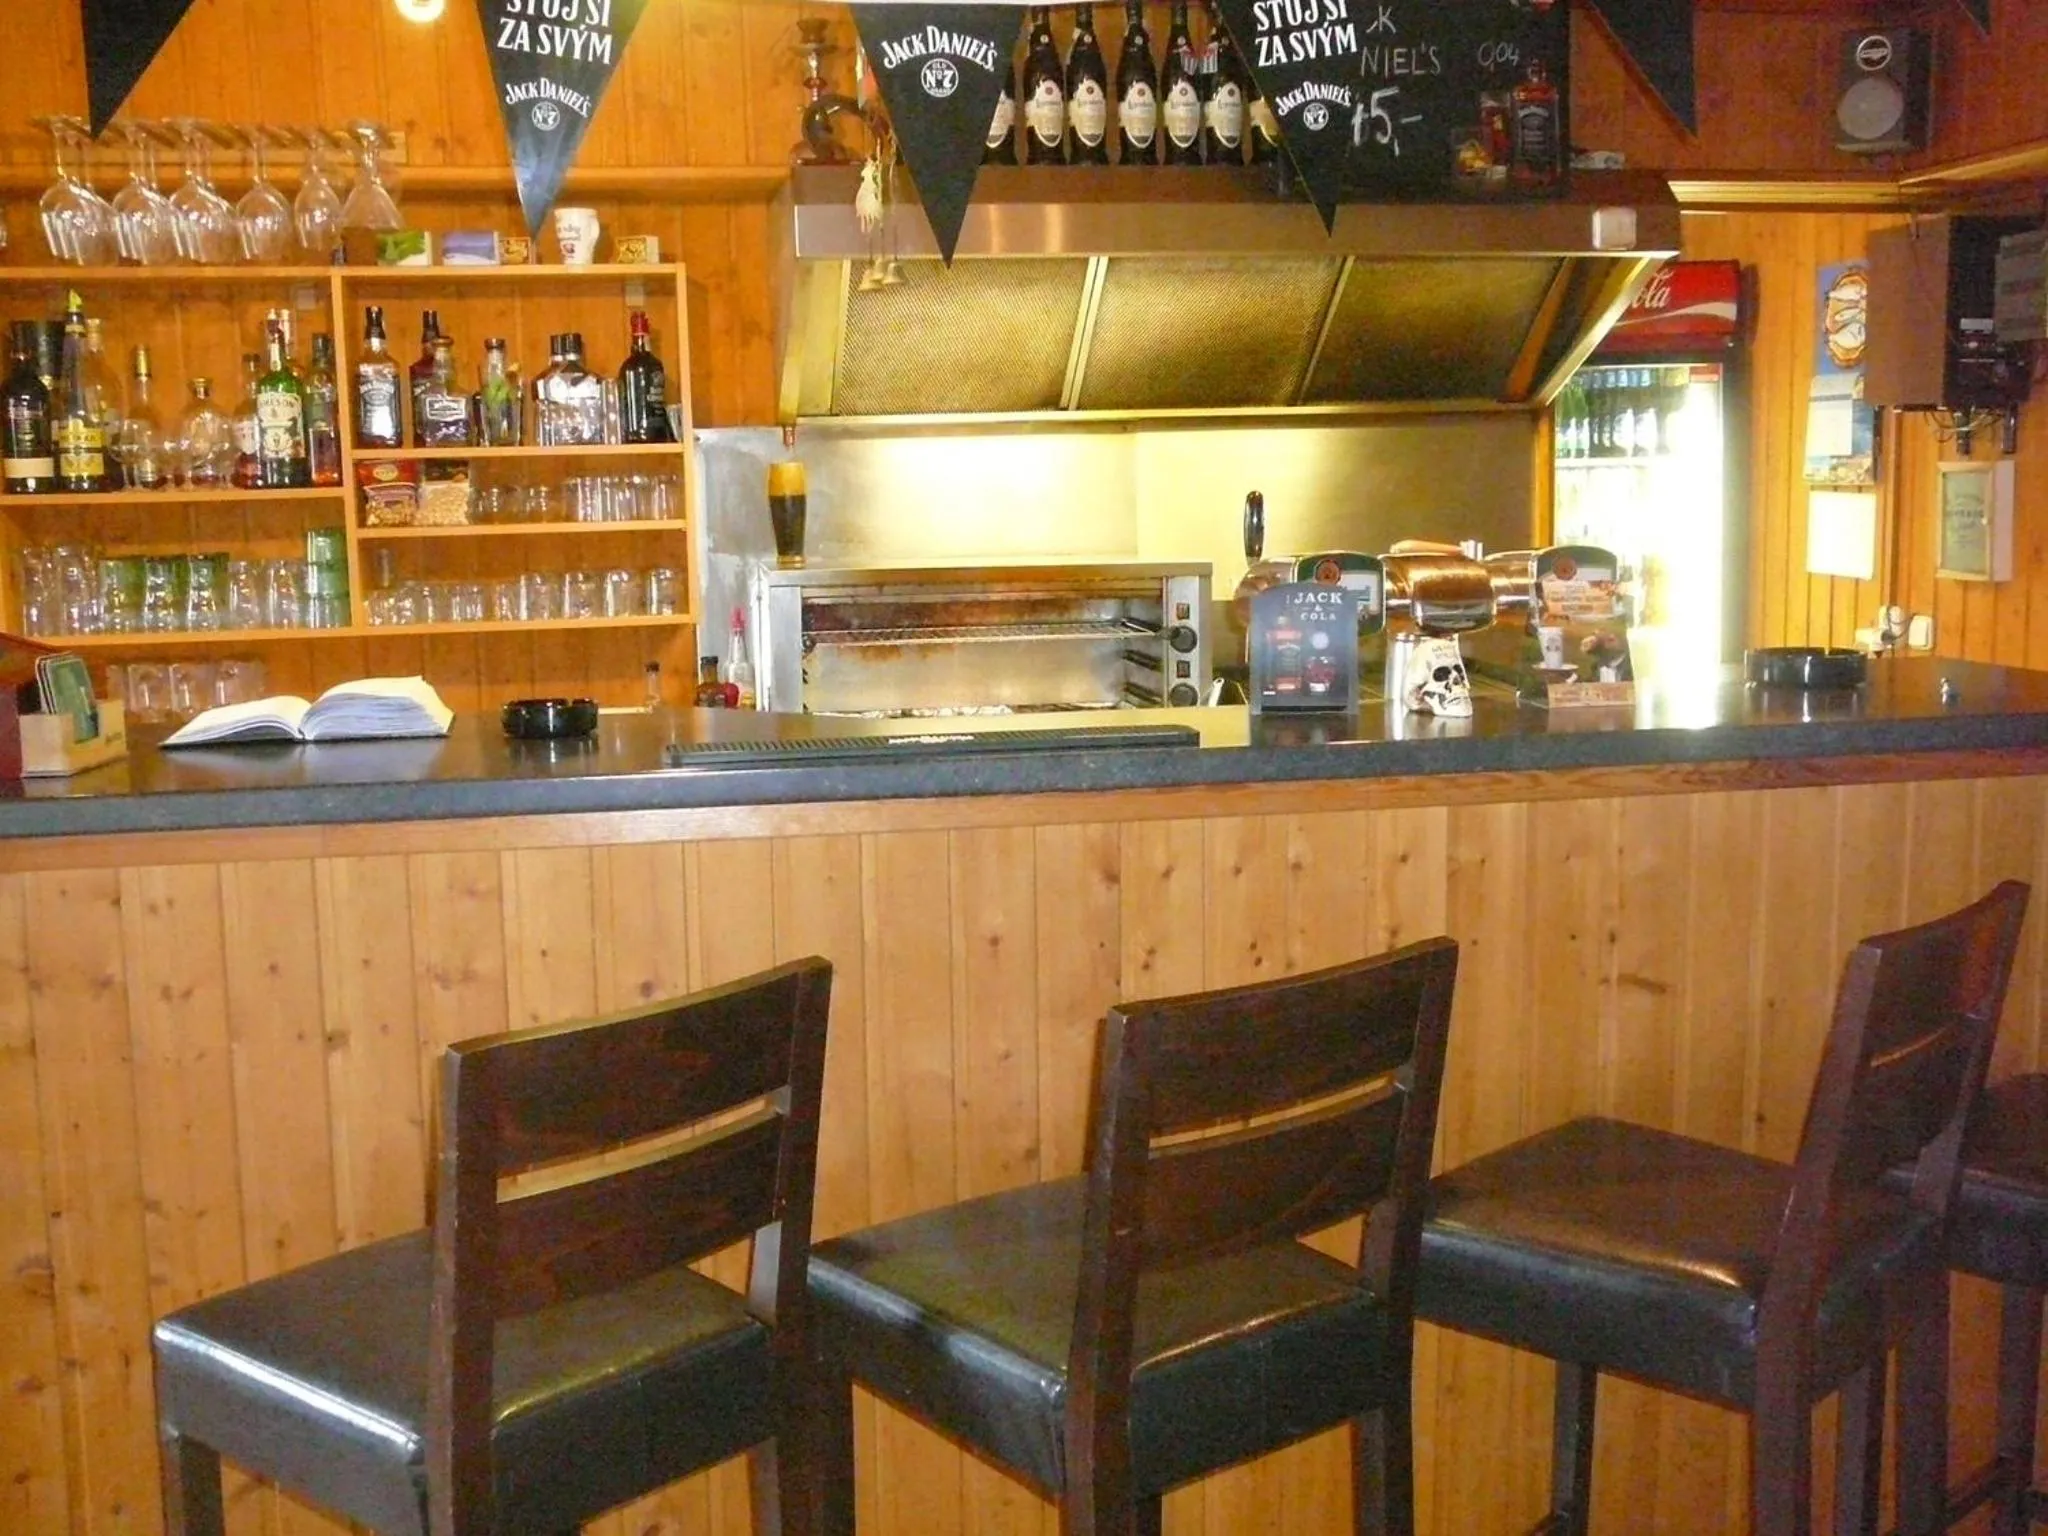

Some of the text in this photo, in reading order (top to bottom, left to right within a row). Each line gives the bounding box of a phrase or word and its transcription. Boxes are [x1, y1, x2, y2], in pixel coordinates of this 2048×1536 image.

[497, 16, 612, 64] ZA SVÝM
[881, 33, 927, 69] JACK
[1255, 21, 1357, 67] ZA SVÝM
[505, 82, 538, 105] JACK
[1275, 87, 1305, 116] JACK
[1294, 592, 1343, 605] JACK
[1300, 612, 1336, 621] COLA
